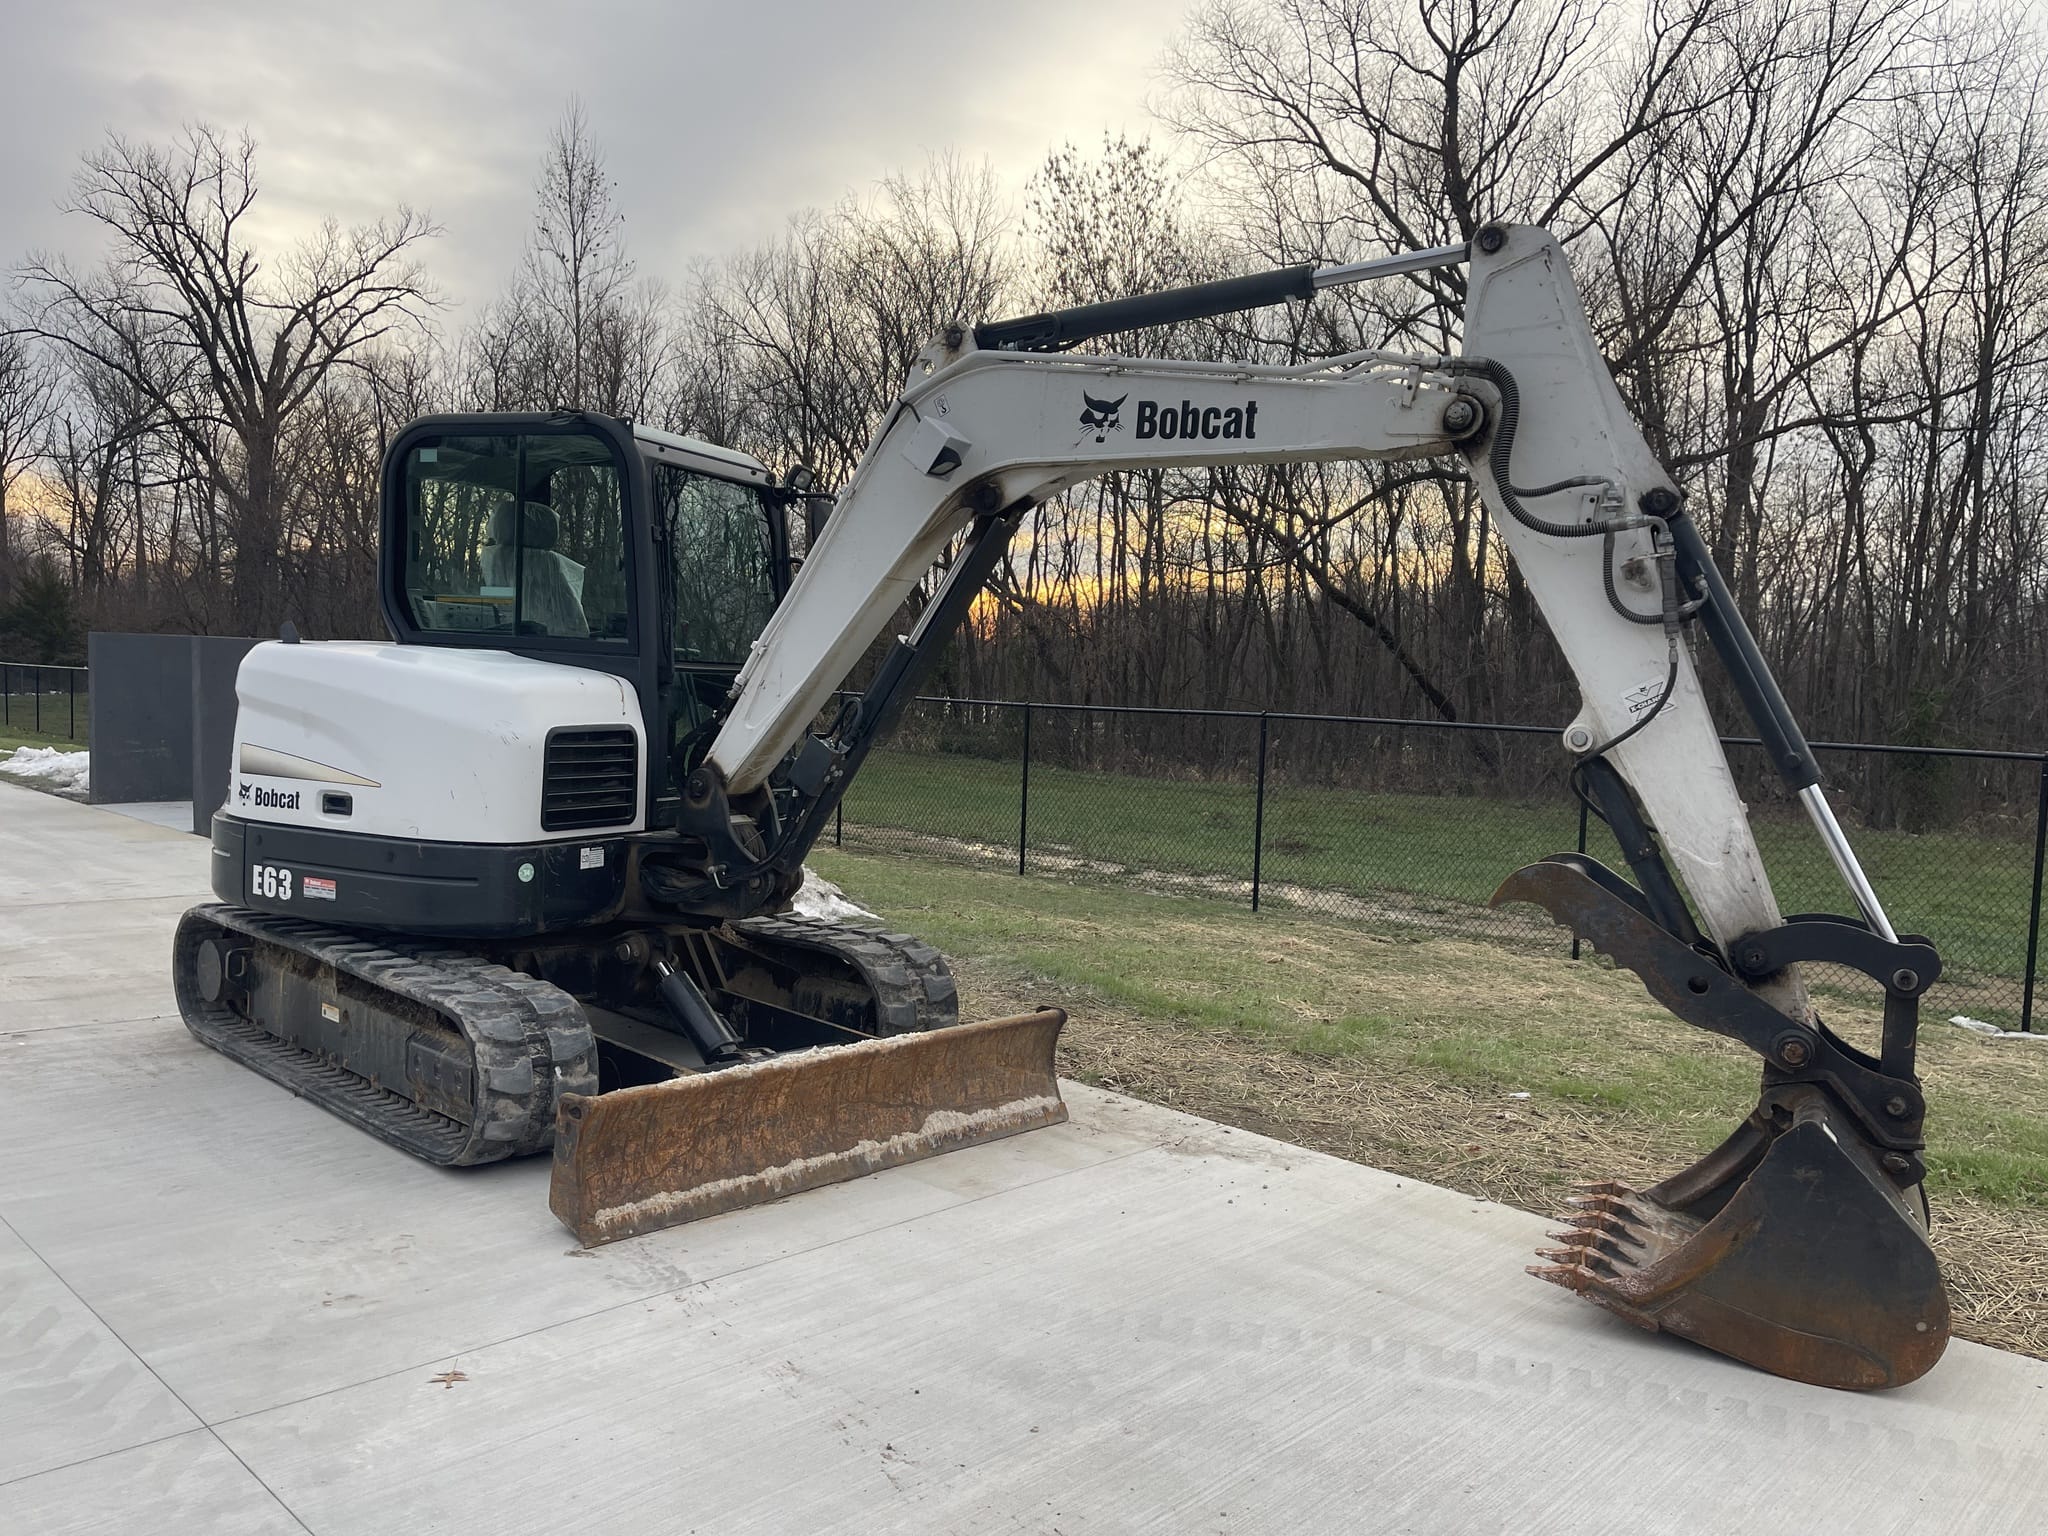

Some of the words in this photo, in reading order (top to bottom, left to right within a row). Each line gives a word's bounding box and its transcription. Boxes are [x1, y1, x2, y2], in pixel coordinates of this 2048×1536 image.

[1136, 400, 1258, 439] Bobcat
[1630, 693, 1664, 712] X-CHAN
[255, 787, 300, 810] Bobcat
[252, 864, 292, 900] E63
